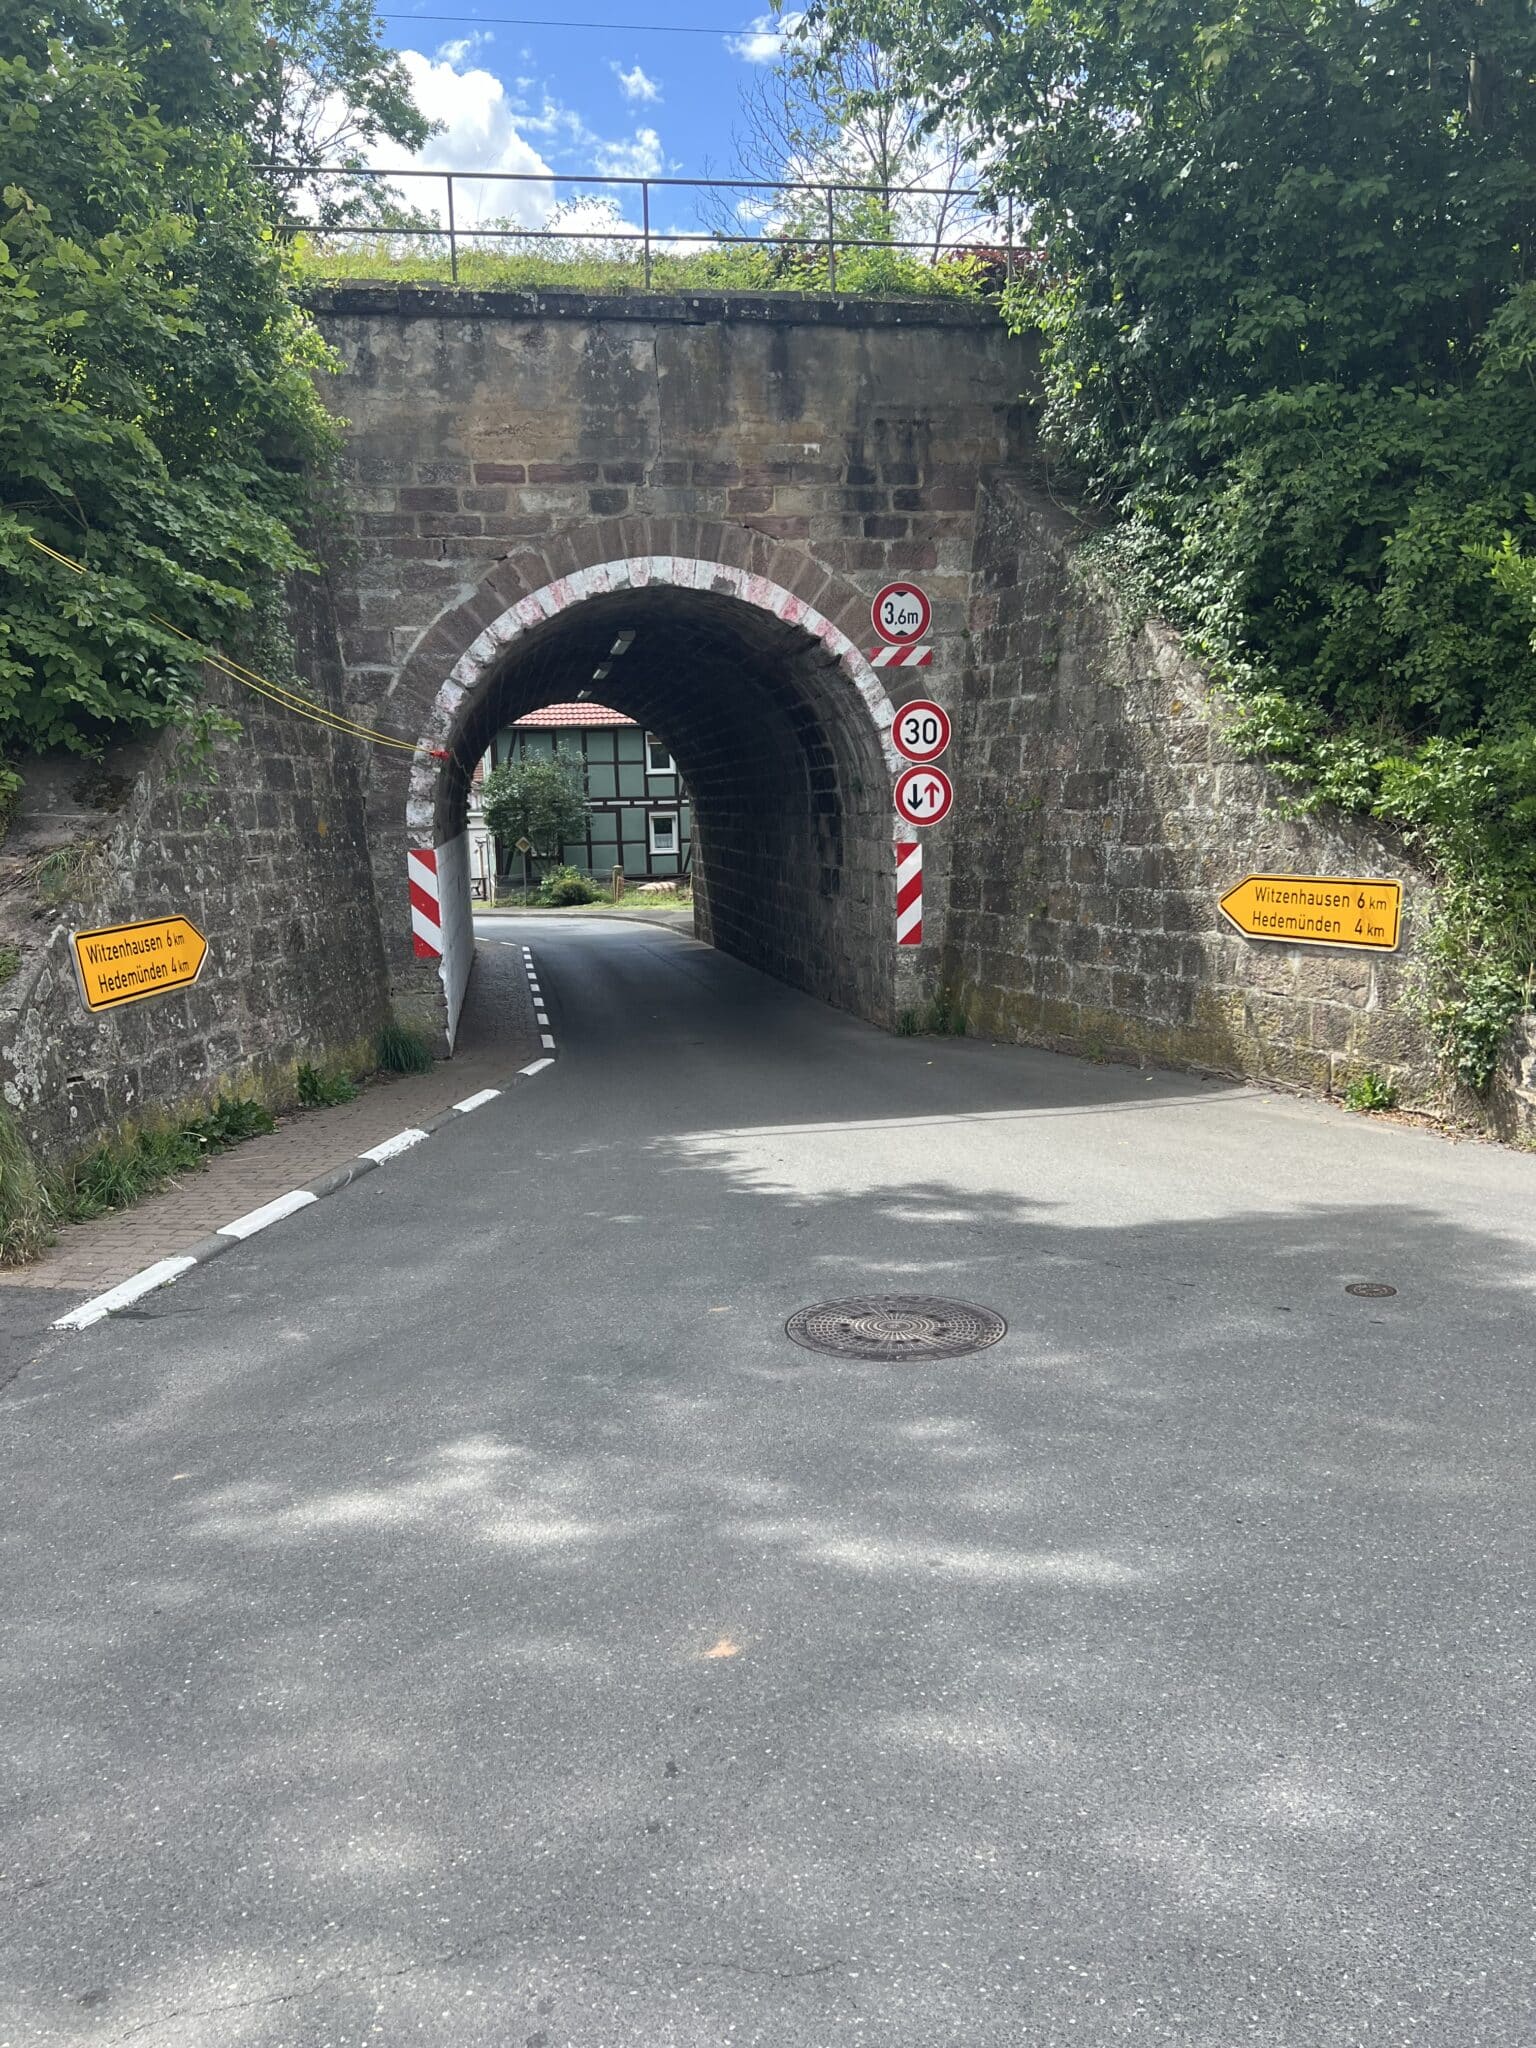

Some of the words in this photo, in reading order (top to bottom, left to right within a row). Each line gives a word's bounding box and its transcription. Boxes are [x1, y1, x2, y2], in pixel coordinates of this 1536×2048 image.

[905, 718, 937, 744] 30
[1255, 886, 1350, 908] Witzenhausen
[1356, 892, 1365, 909] 6
[1369, 896, 1387, 910] km
[1252, 911, 1341, 933] Hedemünden
[1354, 918, 1363, 935] 4
[1367, 922, 1385, 937] km
[86, 935, 163, 964] Witzenhausen
[166, 930, 172, 947] 6
[174, 933, 185, 946] km
[98, 960, 168, 993] Hedemünden
[171, 957, 177, 974] 4
[178, 960, 190, 973] km
